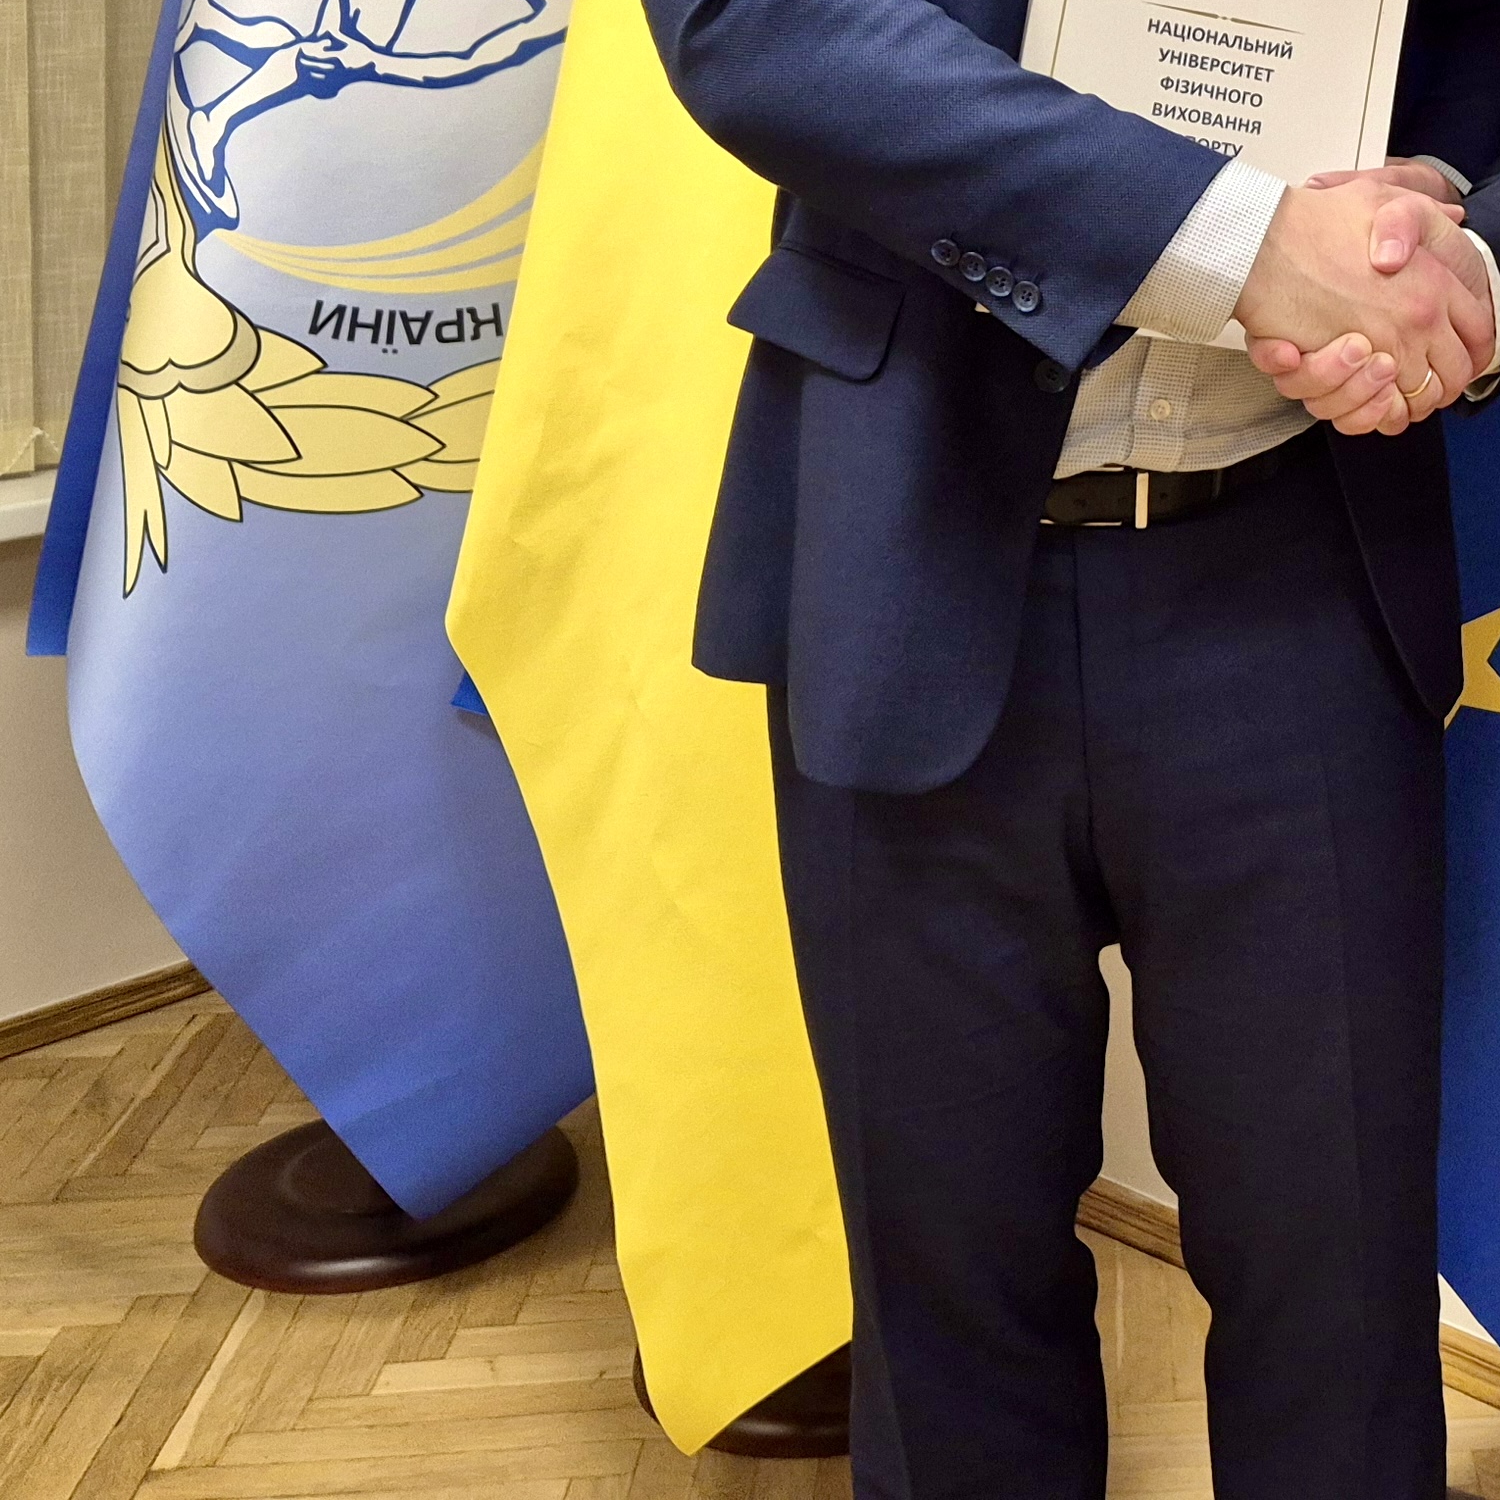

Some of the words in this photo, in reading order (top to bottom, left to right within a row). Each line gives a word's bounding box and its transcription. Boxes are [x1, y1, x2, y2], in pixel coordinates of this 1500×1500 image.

[1147, 18, 1293, 60] НАЦІОНАЛЬНИЙ
[1158, 47, 1275, 83] УНІВЕРСИТЕТ
[1160, 75, 1263, 108] ФІЗИЧНОГО
[1151, 102, 1262, 136] ВИХОВАННЯ
[308, 299, 504, 355] КРАЇНИ
